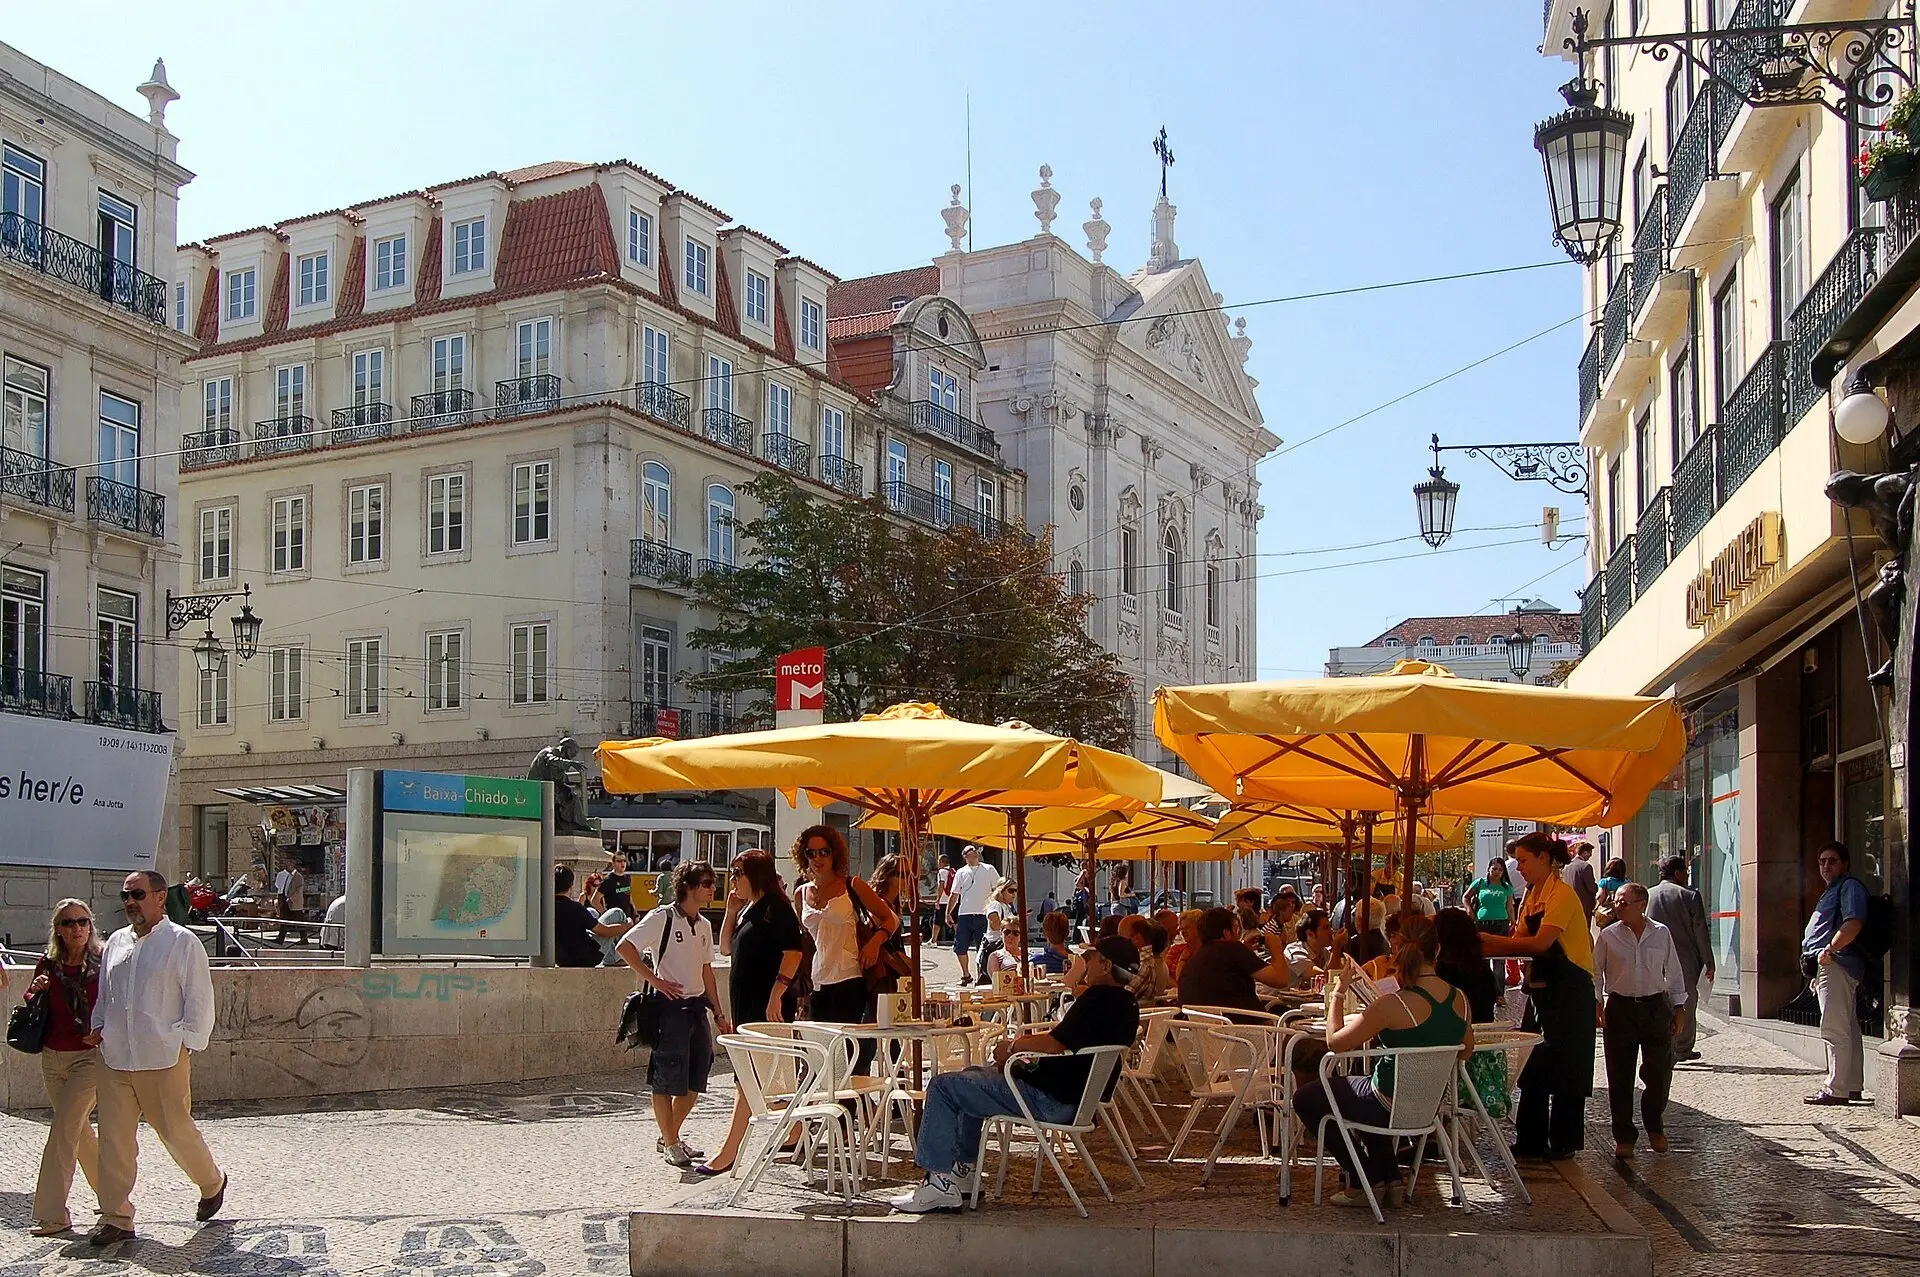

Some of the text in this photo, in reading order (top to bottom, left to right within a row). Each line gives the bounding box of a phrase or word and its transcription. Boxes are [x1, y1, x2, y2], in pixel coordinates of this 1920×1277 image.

[1686, 570, 1716, 629] CASA
[781, 662, 822, 676] metro
[18, 770, 84, 805] her/e
[423, 785, 509, 805] Baixa-Chiado
[93, 798, 124, 809] Ana Jotta
[675, 931, 684, 942] 9
